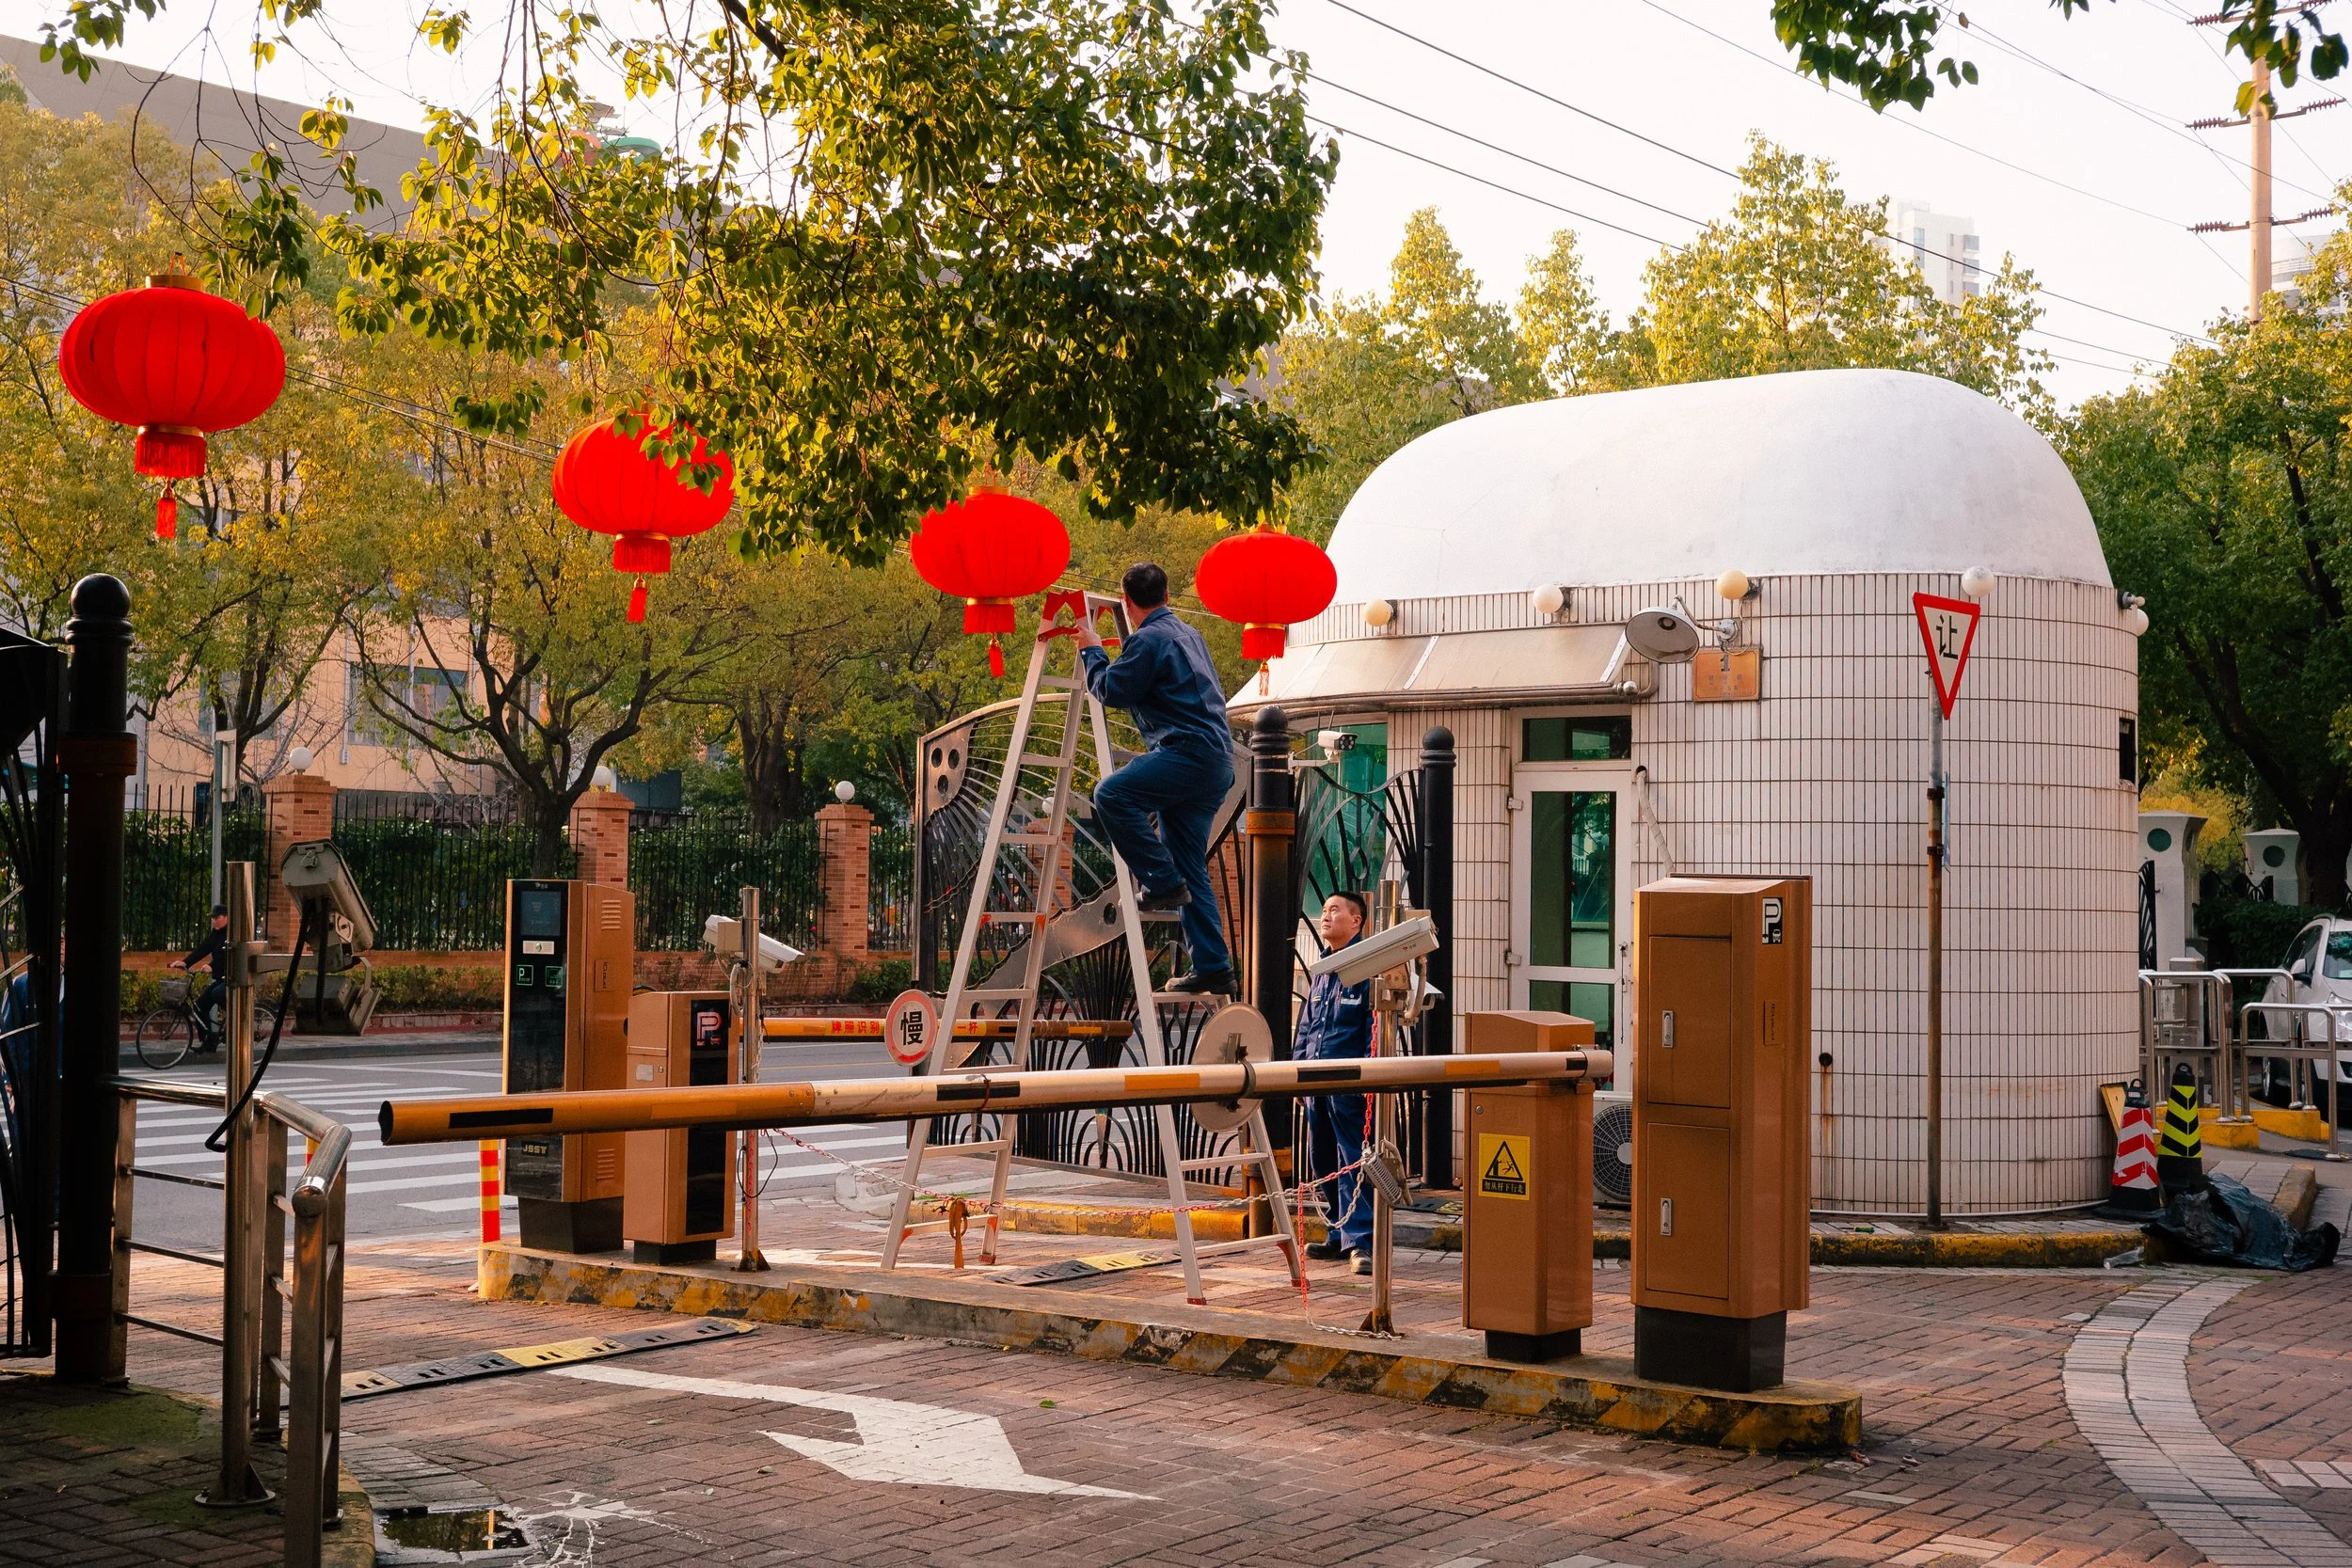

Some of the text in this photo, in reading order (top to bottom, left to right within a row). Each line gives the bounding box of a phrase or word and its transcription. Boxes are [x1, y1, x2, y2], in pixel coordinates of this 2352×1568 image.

[1935, 613, 1959, 660] 让
[1720, 654, 1731, 673] 1
[831, 1021, 978, 1035] 牌照识别 一杆
[899, 1010, 924, 1046] 慢
[522, 1144, 548, 1154] JSST
